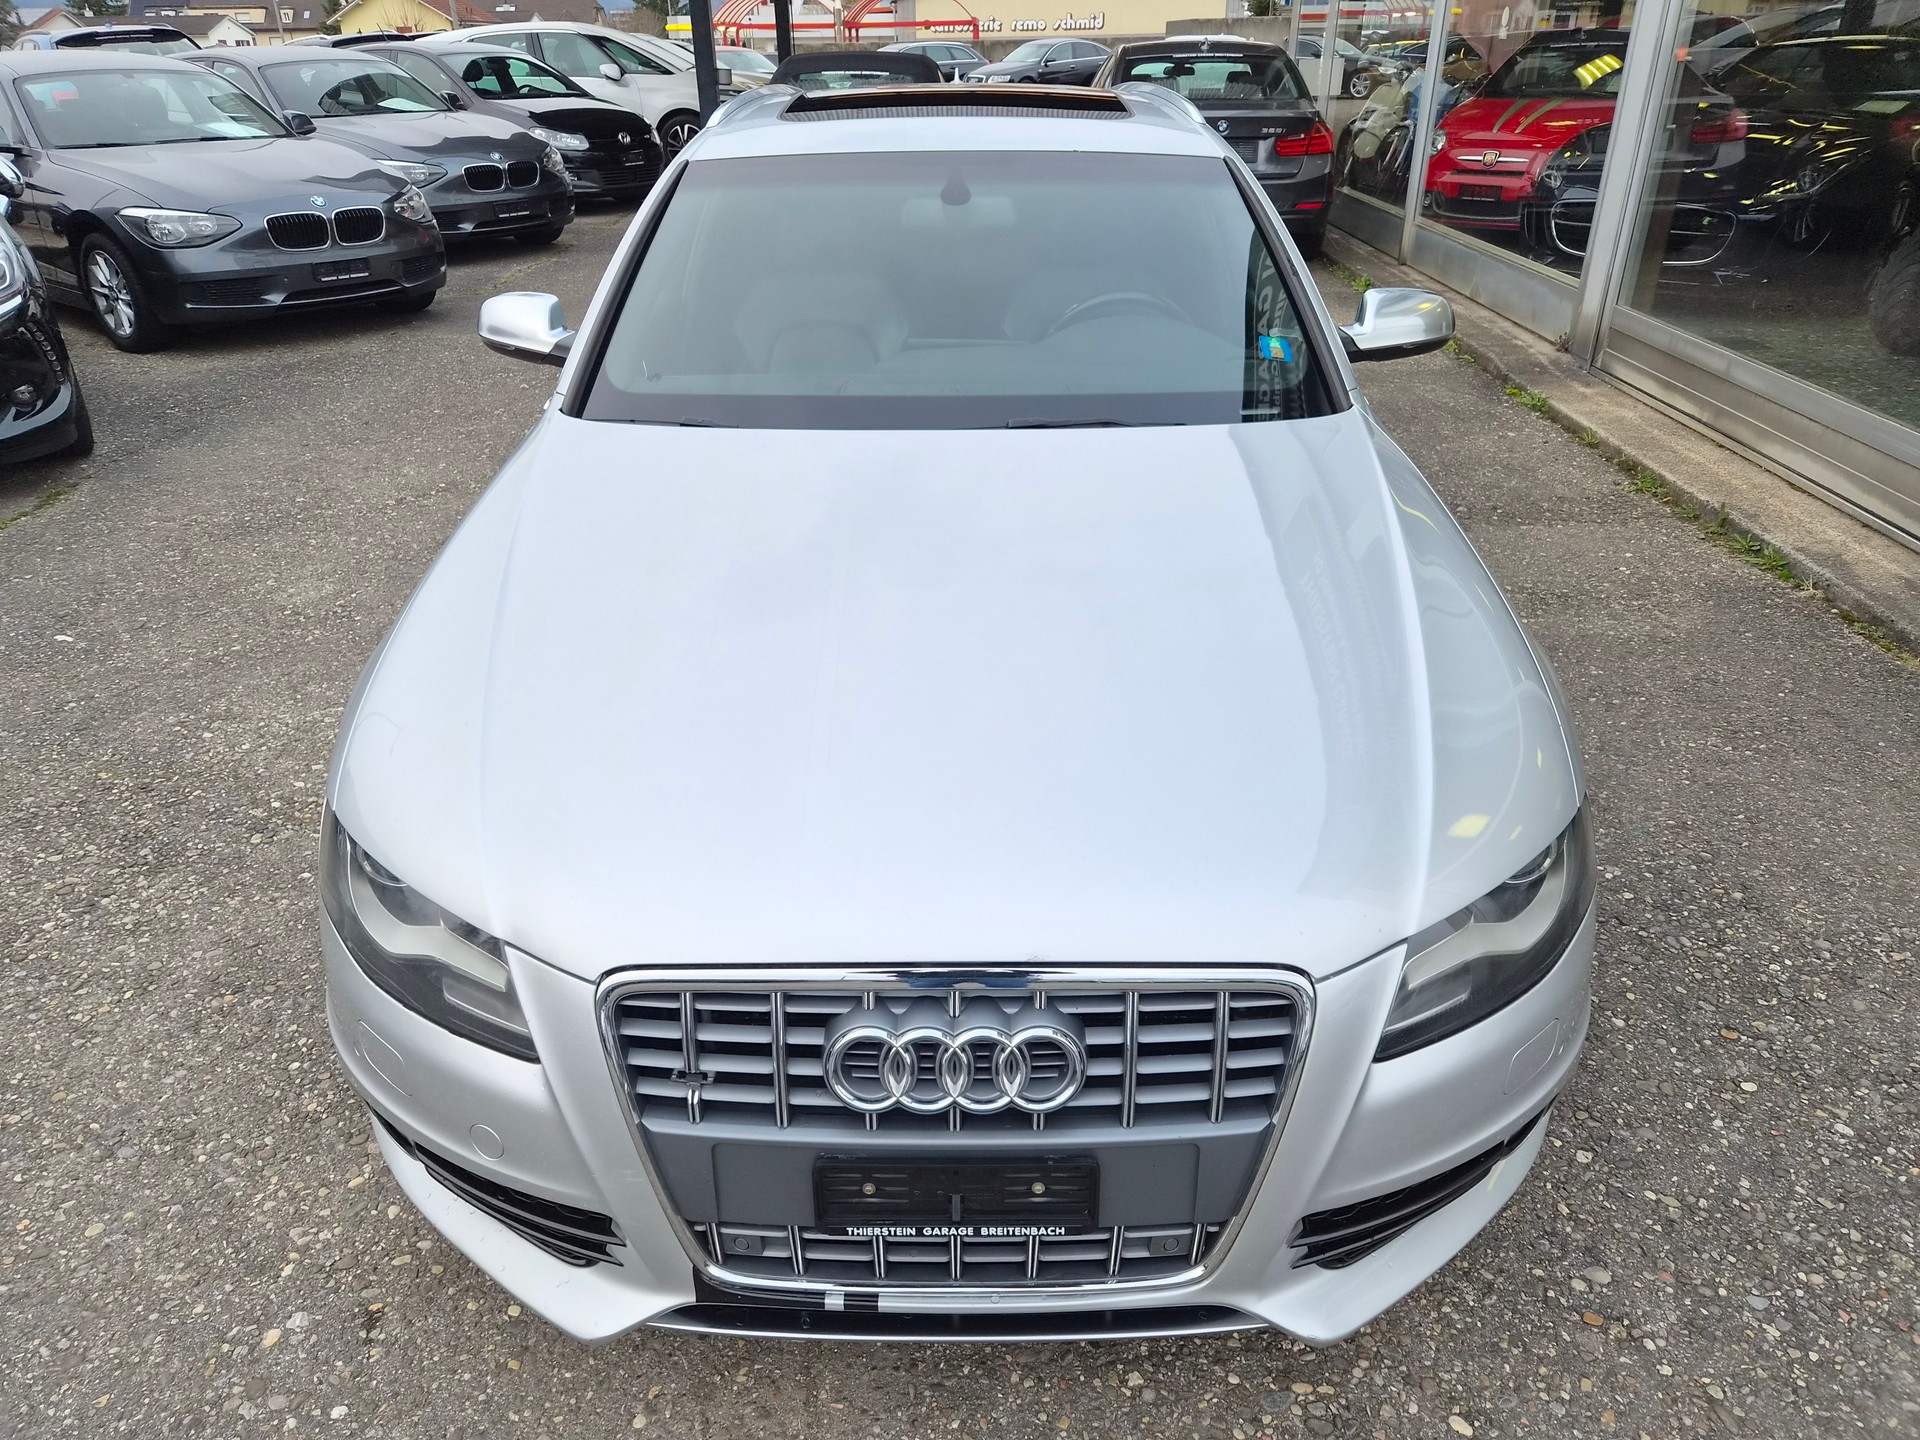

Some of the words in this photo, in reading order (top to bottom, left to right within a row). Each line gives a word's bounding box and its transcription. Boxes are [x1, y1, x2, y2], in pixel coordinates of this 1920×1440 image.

[1010, 18, 1047, 31] remo
[1052, 11, 1105, 31] schmid
[846, 1227, 916, 1236] THIERSTEIN
[923, 1227, 974, 1236] GARAGE
[980, 1227, 1065, 1236] BREITENBACH
